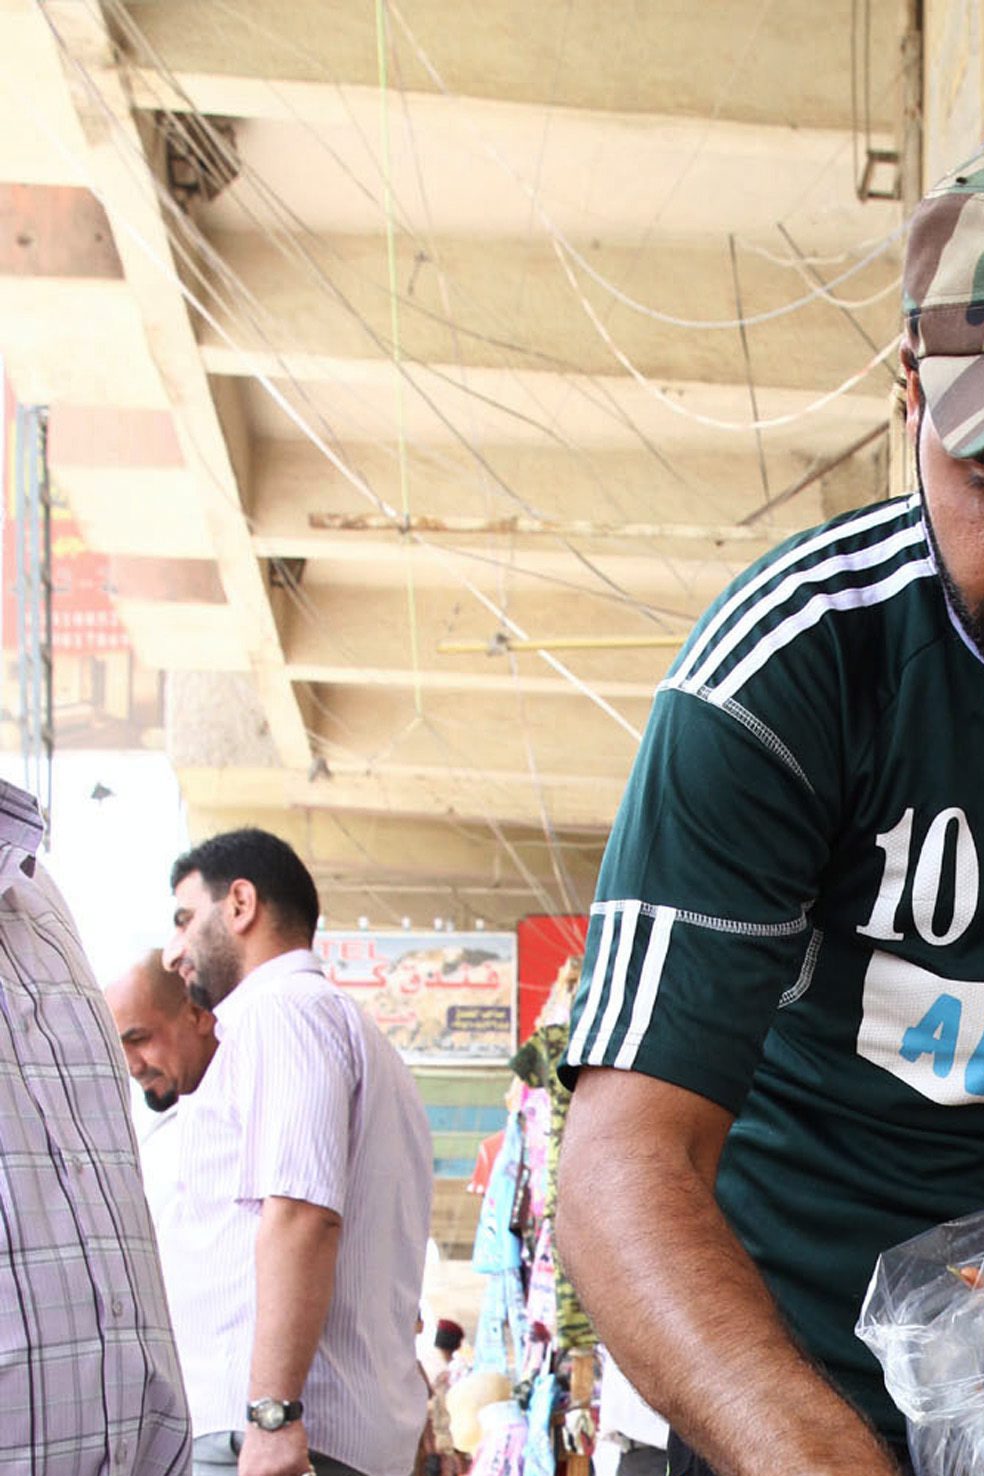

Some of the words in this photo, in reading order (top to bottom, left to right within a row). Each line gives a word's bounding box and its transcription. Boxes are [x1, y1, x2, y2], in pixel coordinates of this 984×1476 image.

[856, 806, 980, 946] 10
[314, 939, 388, 960] TEL
[400, 963, 500, 994] فندق
